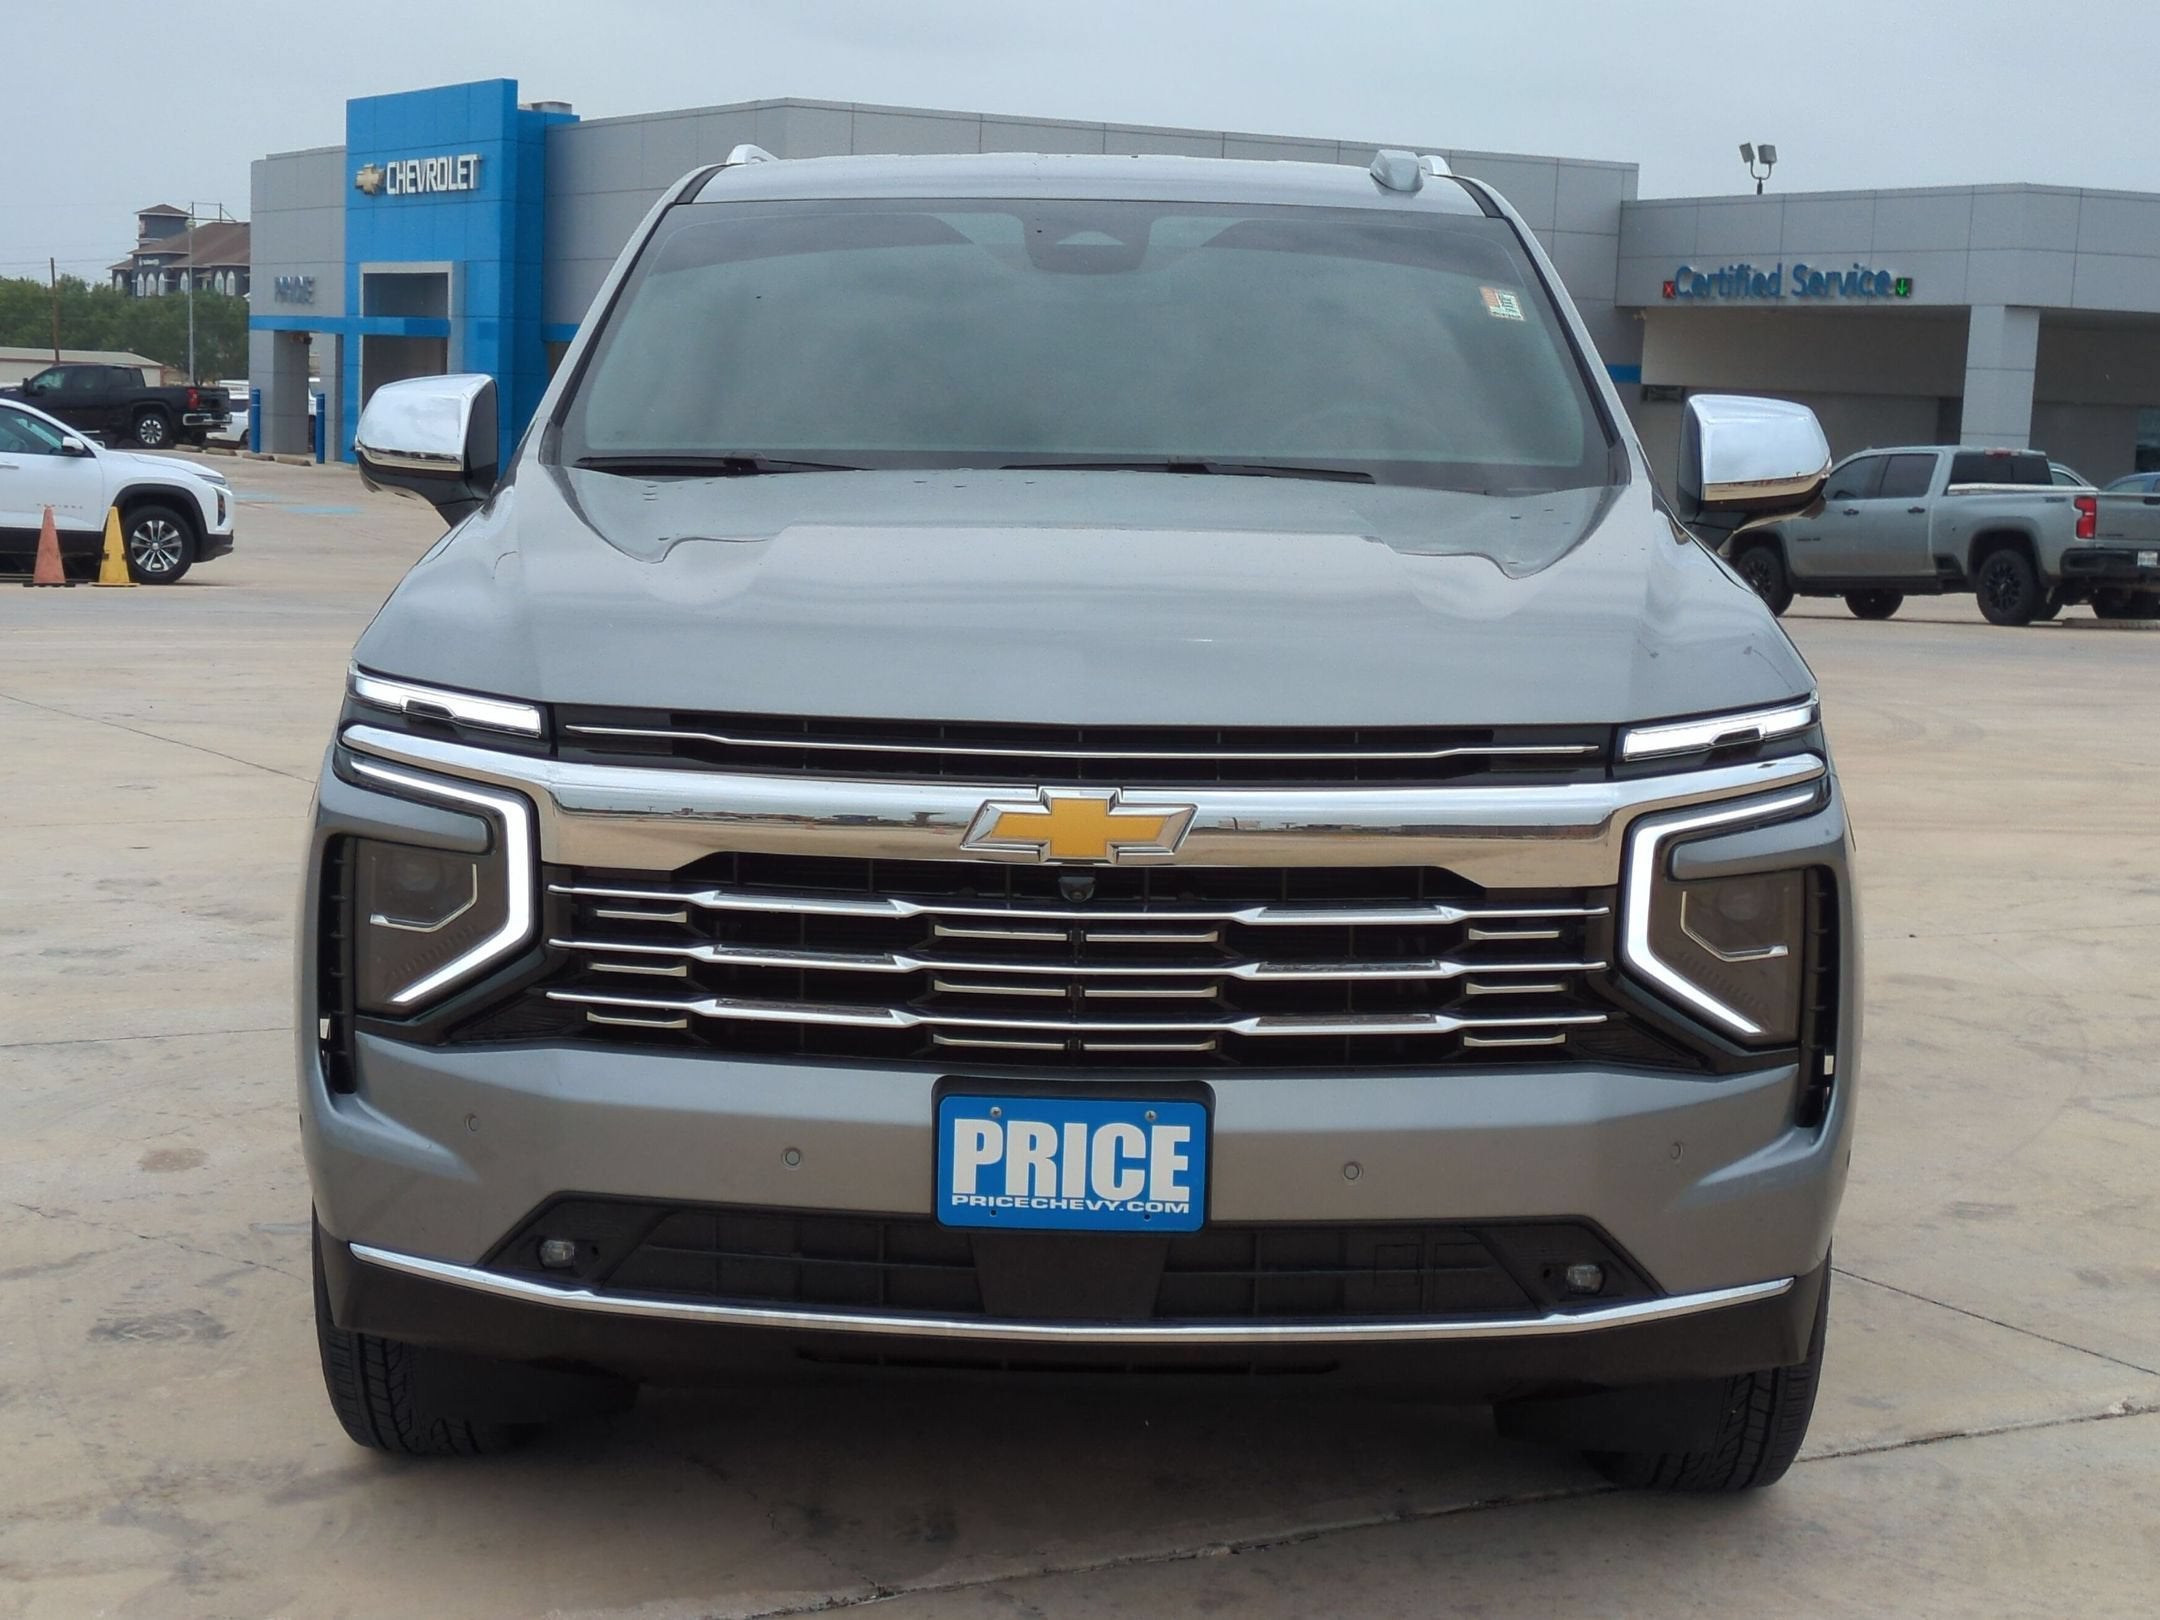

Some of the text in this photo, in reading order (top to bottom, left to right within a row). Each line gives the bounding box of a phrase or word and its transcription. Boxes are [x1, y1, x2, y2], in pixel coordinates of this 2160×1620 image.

[386, 153, 479, 195] CHEVROLET
[1675, 262, 1892, 297] Certified Service
[952, 1118, 1191, 1202] PRICE
[951, 1195, 1189, 1214] PRICECHEVY.COM
